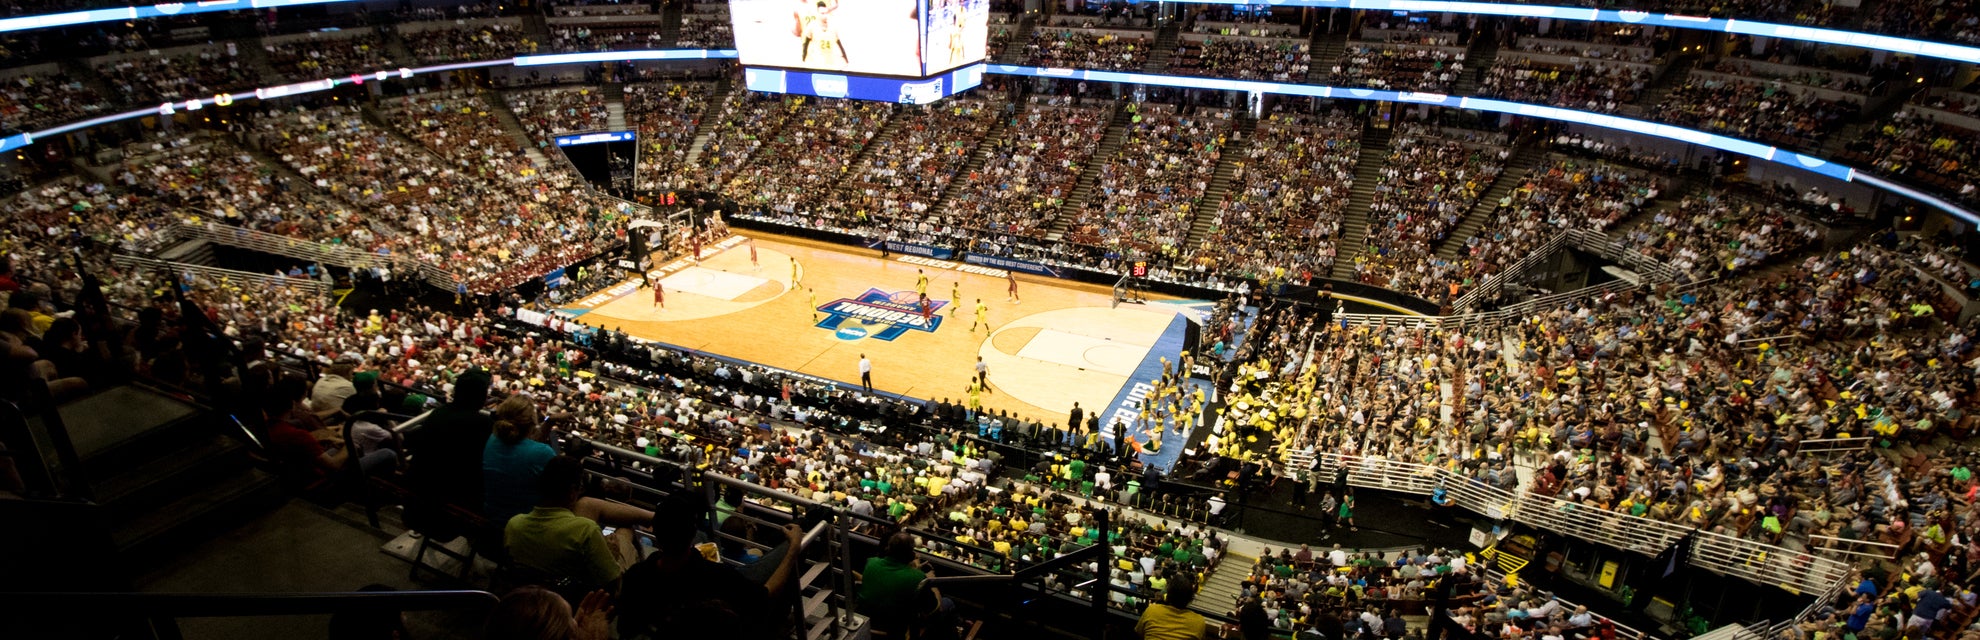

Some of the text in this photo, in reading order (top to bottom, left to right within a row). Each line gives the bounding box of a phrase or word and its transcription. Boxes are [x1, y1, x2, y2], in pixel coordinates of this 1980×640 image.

[887, 242, 934, 256] WEST REGIONAL
[897, 255, 957, 269] CENTER
[1016, 261, 1043, 271] CONFERENCE
[578, 293, 612, 307] THE
[608, 278, 644, 296] ROAD
[660, 260, 689, 272] THE
[714, 235, 748, 249] FOUR
[1133, 266, 1145, 275] 30
[833, 302, 926, 326] REGIONAL
[1121, 382, 1155, 410] ELITE
